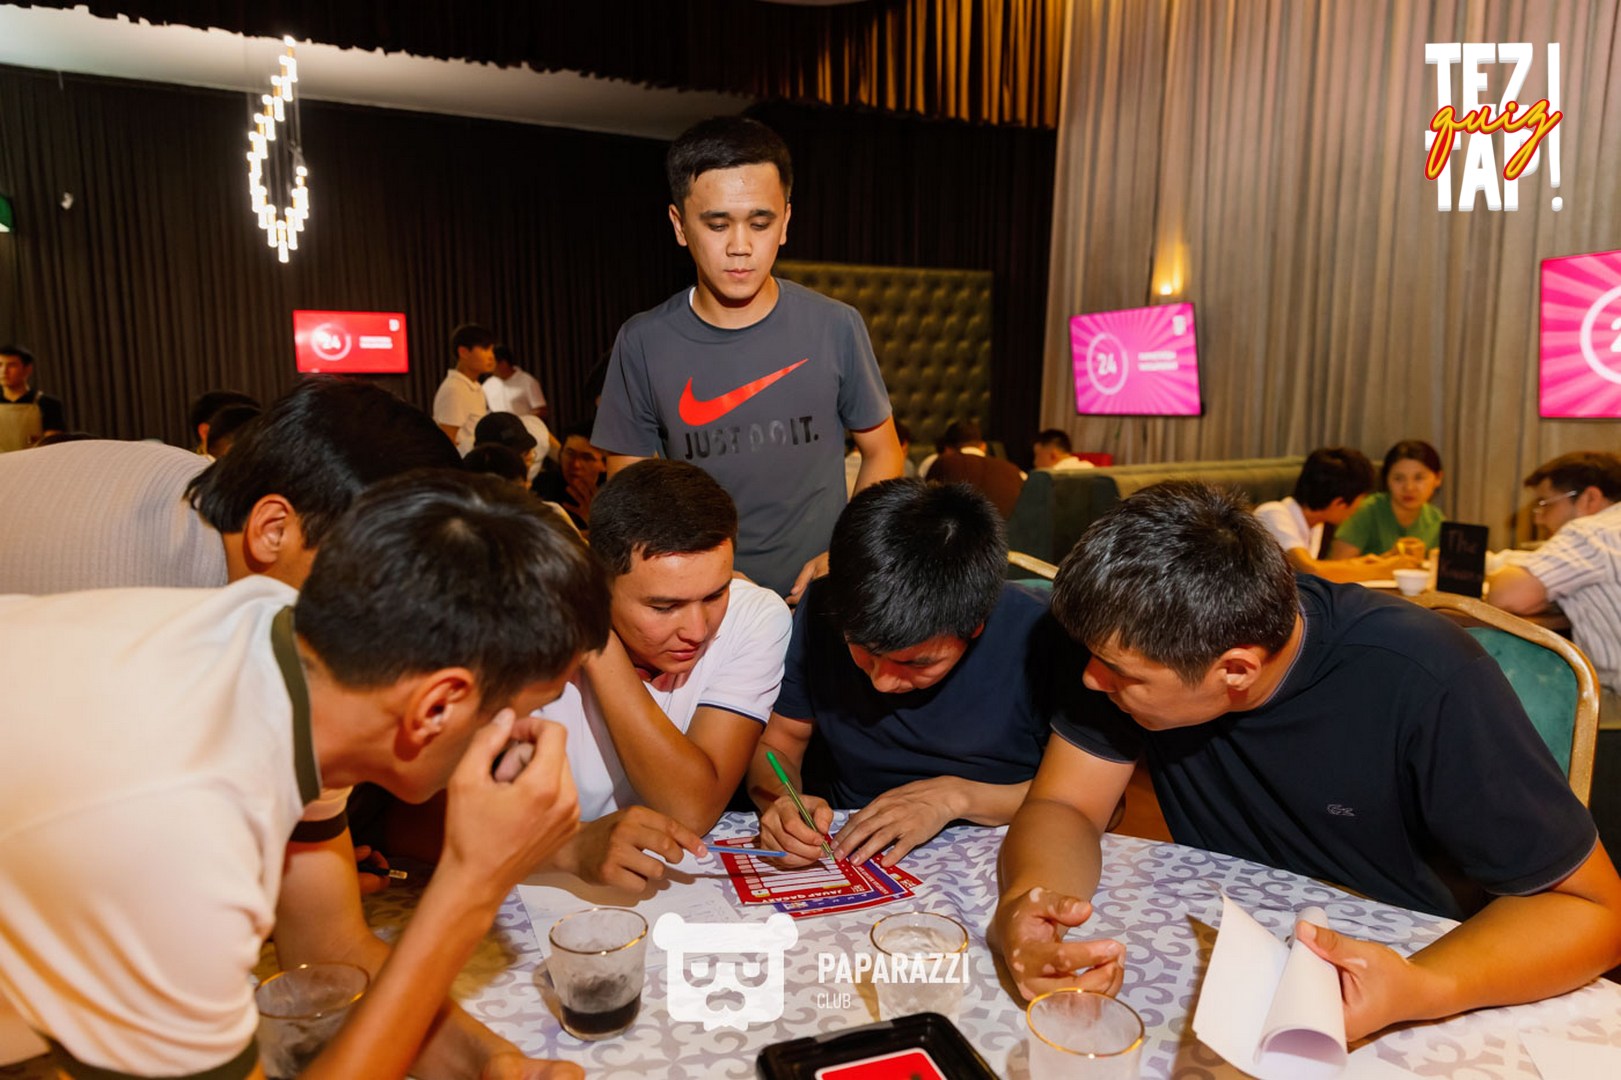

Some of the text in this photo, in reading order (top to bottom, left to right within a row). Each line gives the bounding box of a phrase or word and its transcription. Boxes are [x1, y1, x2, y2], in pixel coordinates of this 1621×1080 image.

[1097, 352, 1117, 375] 24
[685, 427, 741, 460] JUST
[750, 420, 787, 452] DO
